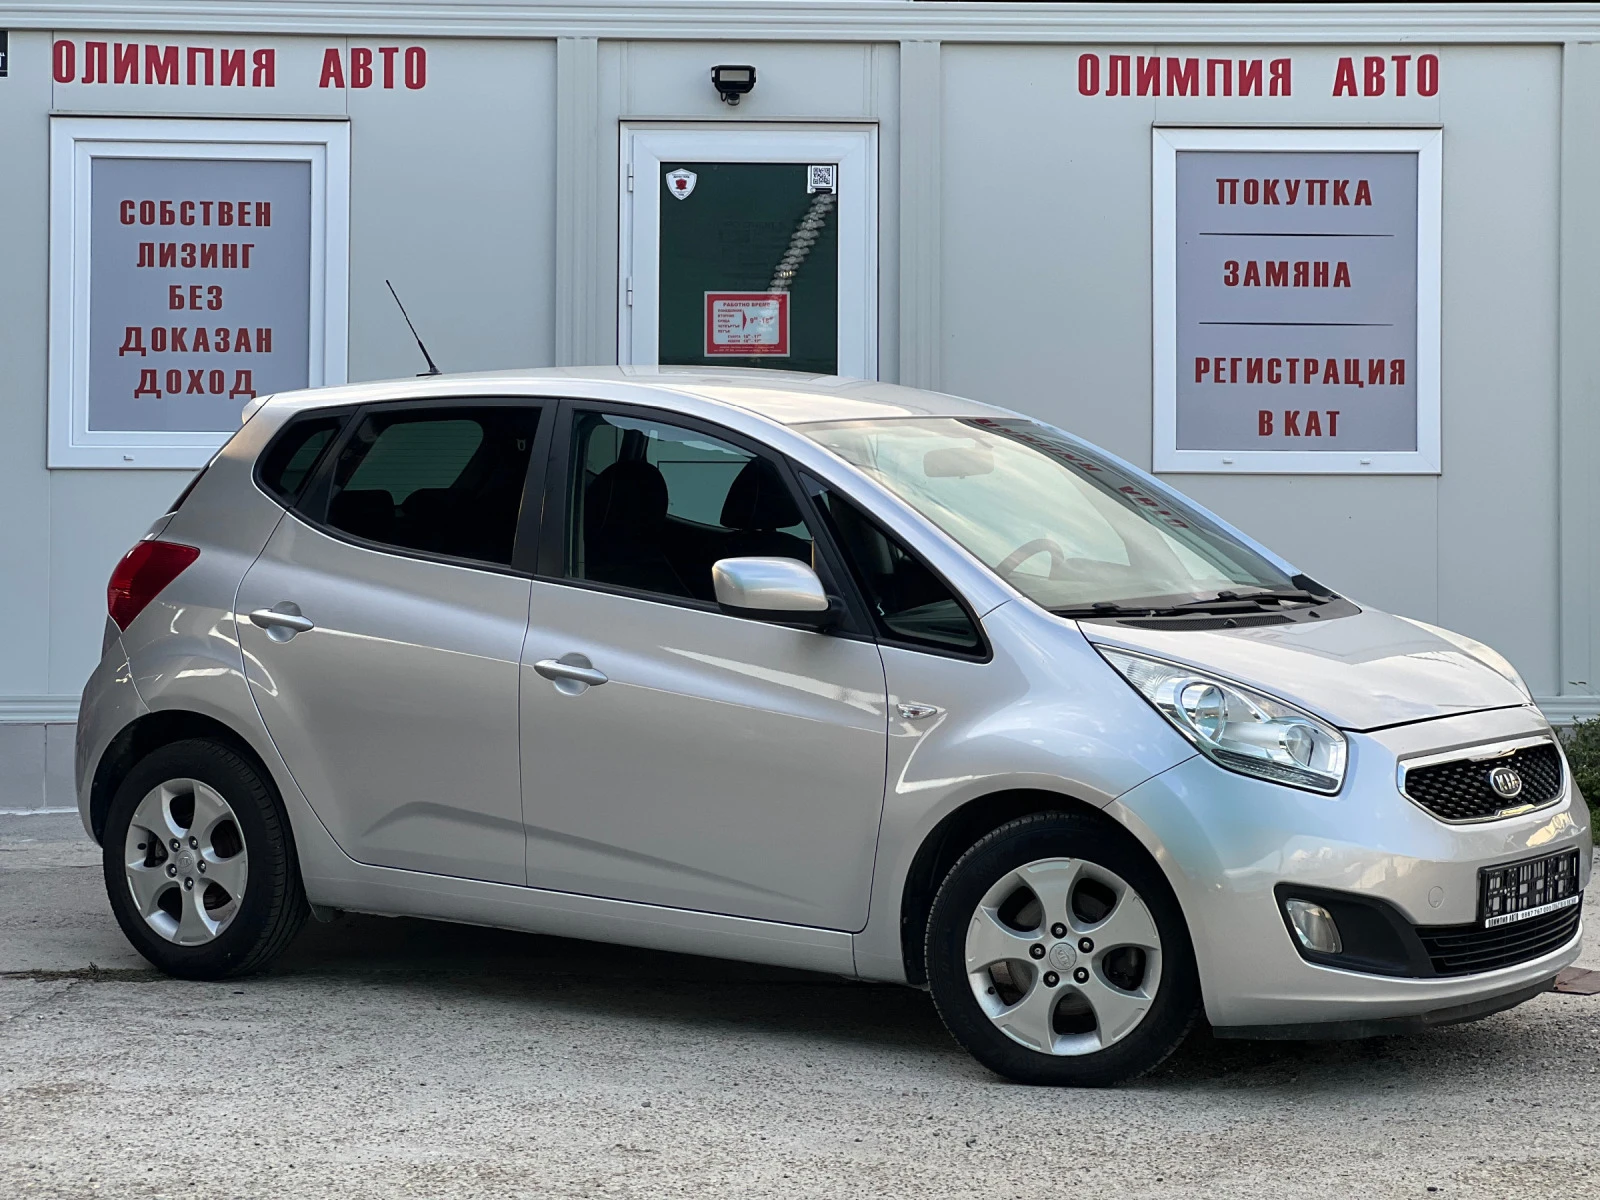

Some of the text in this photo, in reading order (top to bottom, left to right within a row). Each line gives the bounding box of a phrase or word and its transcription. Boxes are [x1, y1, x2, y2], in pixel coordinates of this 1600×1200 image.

[53, 40, 427, 90] ОЛИМПИЯ АВТО
[1078, 53, 1439, 97] ОЛИМПИЯ АВТО
[1216, 178, 1373, 206] ПОКУПКА
[119, 200, 271, 227] СОБСТВЕН
[137, 243, 255, 268] ЛИЗИНГ
[1223, 260, 1351, 288] ЗАМЯНА
[169, 285, 223, 310] БЕЗ
[119, 327, 272, 356] ДОКАЗАН
[134, 369, 256, 399] ДОХОД
[1195, 357, 1405, 388] РЕГИСТРАЦИЯ
[1258, 410, 1340, 437] В КАТ
[1495, 773, 1519, 791] KIA
